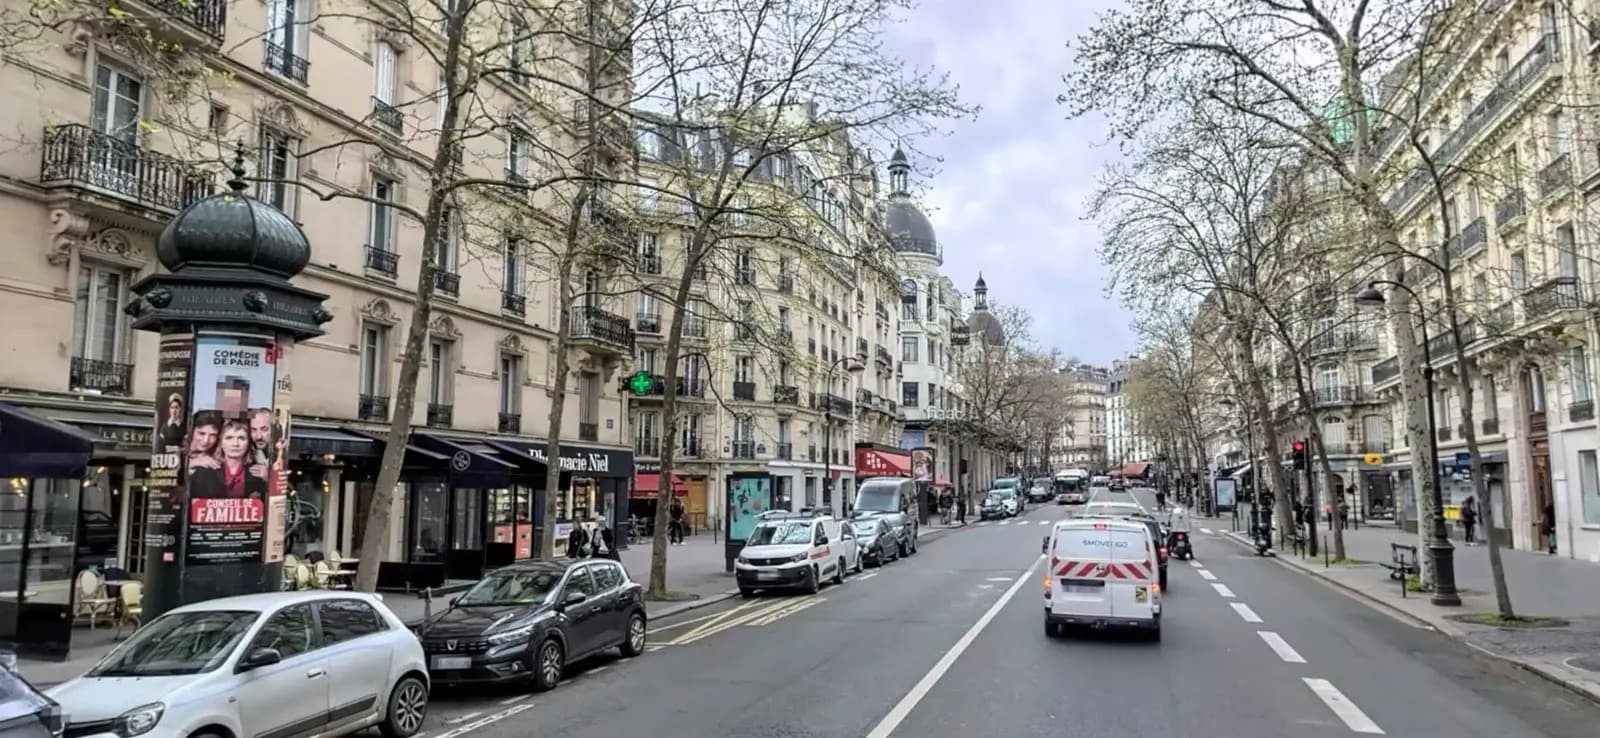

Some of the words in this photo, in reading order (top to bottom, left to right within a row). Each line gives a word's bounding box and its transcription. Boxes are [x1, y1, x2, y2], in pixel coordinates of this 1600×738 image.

[213, 349, 260, 360] COMÉDIE
[213, 358, 228, 366] DE
[230, 358, 260, 368] PARIS
[103, 431, 117, 440] LA
[528, 448, 588, 472] Phmacie
[588, 453, 610, 473] Niel
[206, 498, 243, 509] CONSEIL
[244, 498, 253, 508] DE
[196, 506, 259, 523] FAMILLE
